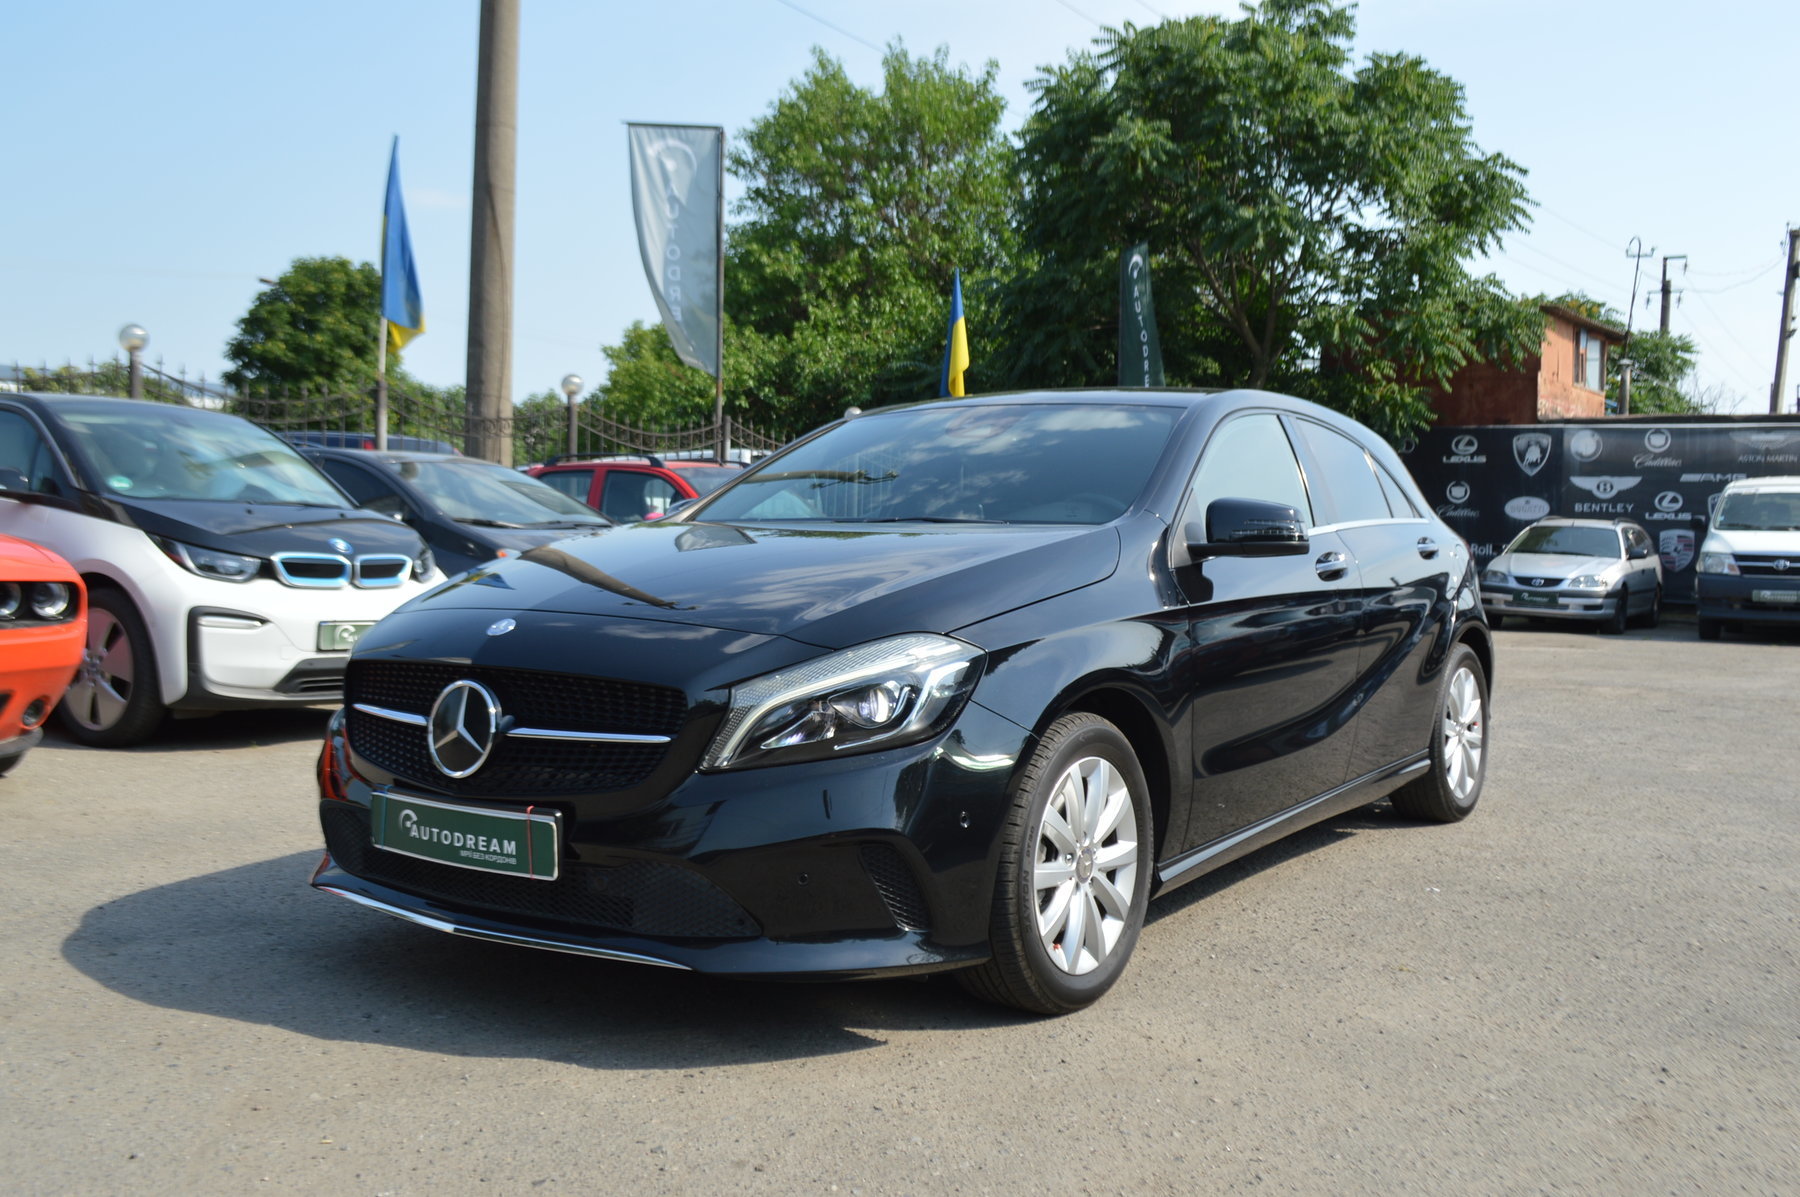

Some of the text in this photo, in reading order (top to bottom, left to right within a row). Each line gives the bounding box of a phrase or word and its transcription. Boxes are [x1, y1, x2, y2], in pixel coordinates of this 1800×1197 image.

[1442, 455, 1487, 463] LEXUS
[1766, 454, 1798, 464] MARTIN
[1574, 502, 1634, 513] BENTLEY
[1645, 512, 1692, 520] LEXUS
[410, 825, 516, 855] AUTODREAM
